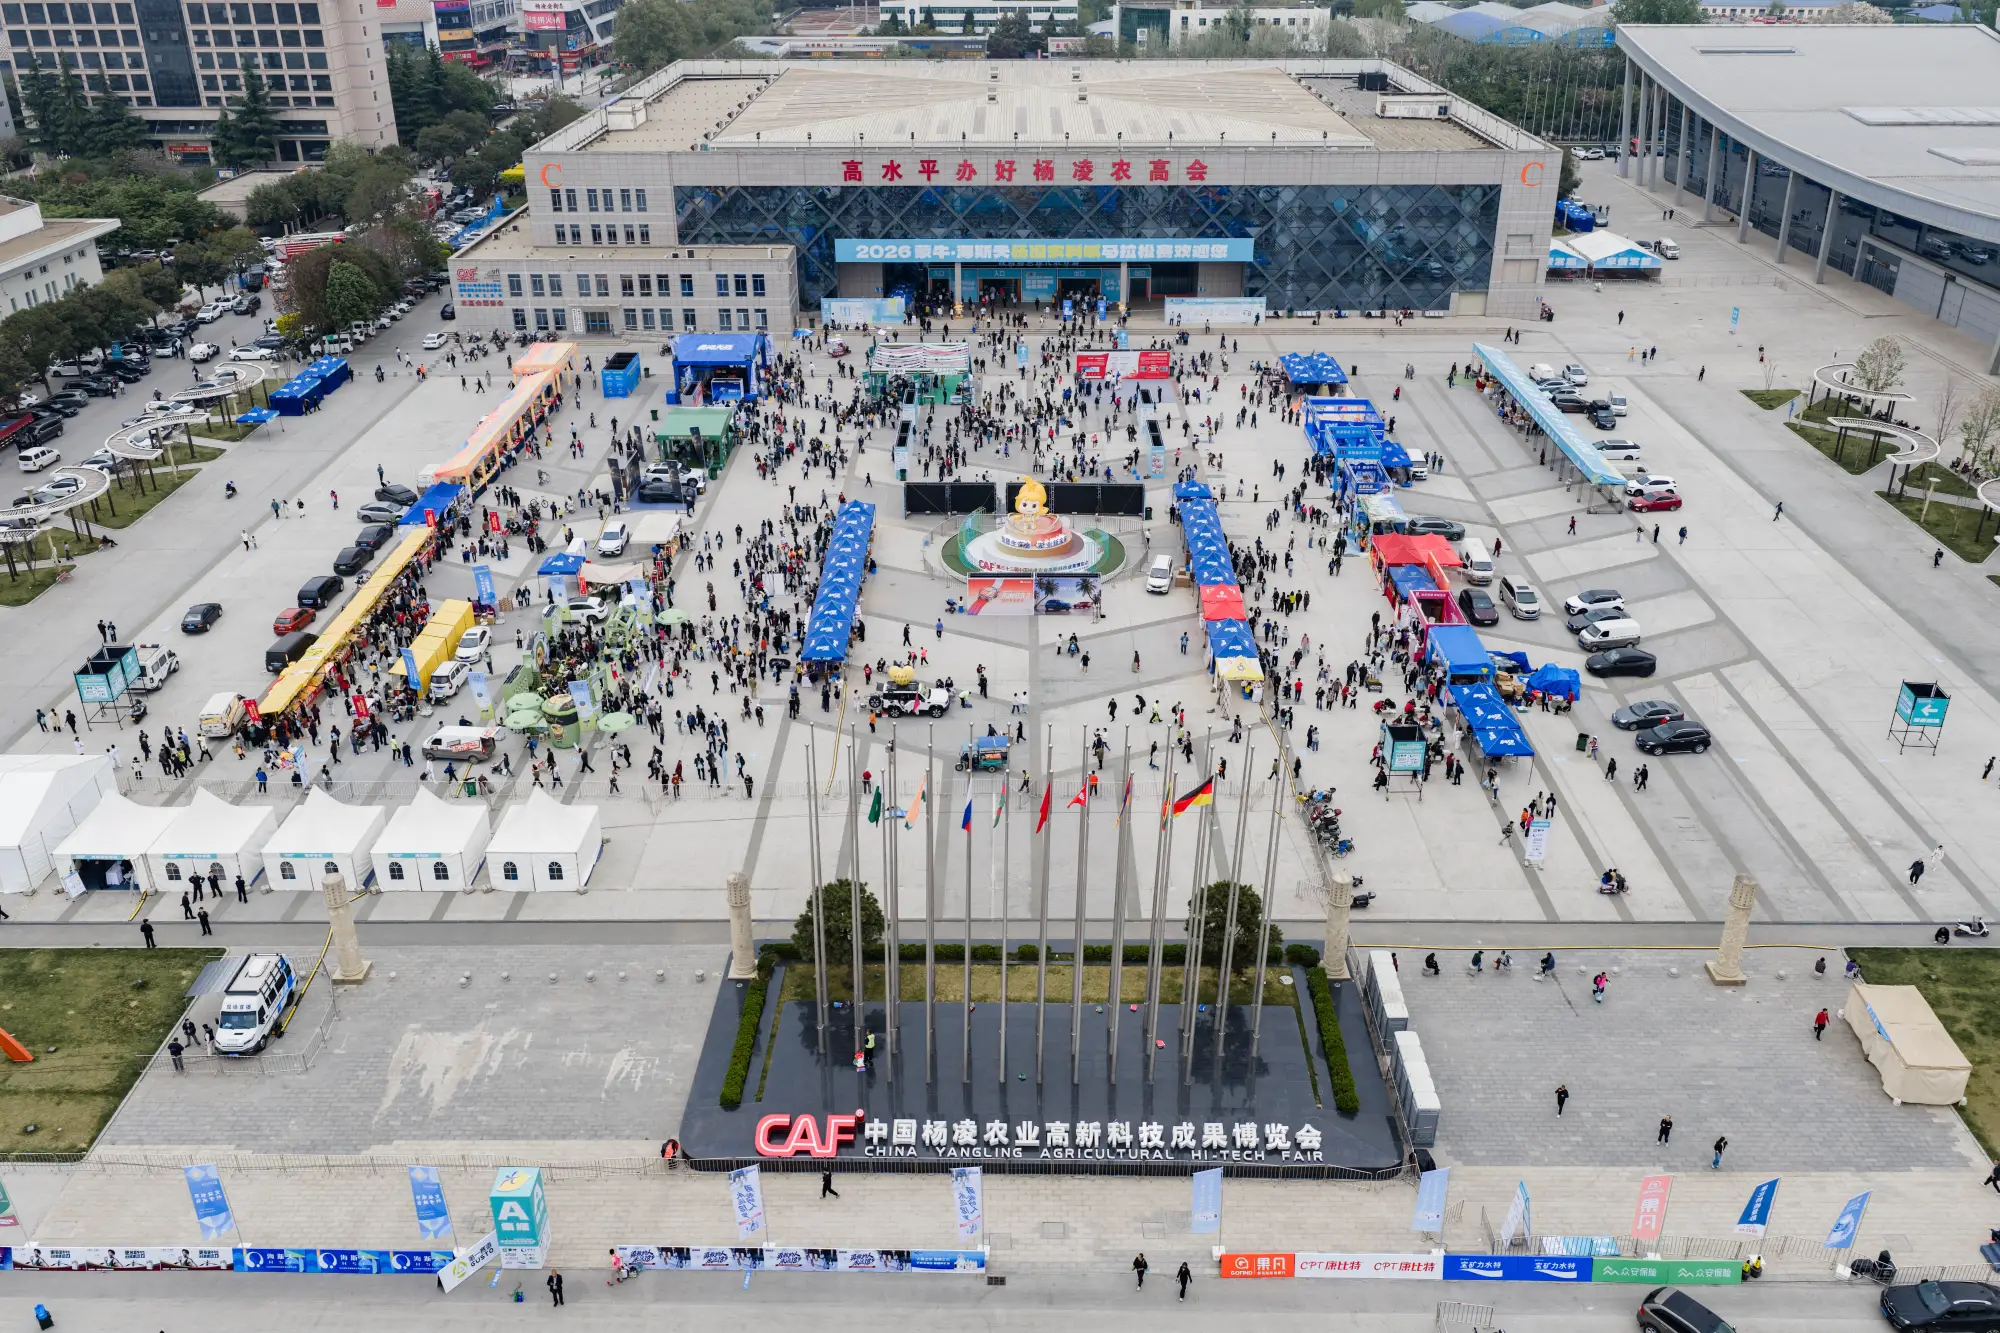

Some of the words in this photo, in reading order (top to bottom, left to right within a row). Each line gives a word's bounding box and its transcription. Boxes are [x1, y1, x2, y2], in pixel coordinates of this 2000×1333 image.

[541, 163, 562, 188] C
[842, 159, 1209, 182] 高水平办好杨凌农高会
[1520, 161, 1545, 187] C
[855, 244, 911, 259] 2026
[755, 1113, 856, 1158] CAF
[864, 1118, 1322, 1150] 中国杨凌农业高新科技成果博览会
[864, 1146, 918, 1157] CHINA
[936, 1147, 1023, 1158] YANGLING
[1040, 1148, 1175, 1160] AGRICULTURAL
[1191, 1150, 1265, 1161] HI-TECH
[1282, 1151, 1323, 1162] FAIR
[498, 1201, 530, 1220] A
[470, 1247, 494, 1267] GUSTO
[1257, 1257, 1286, 1270] 果凡
[1459, 1261, 1501, 1269] 宝矿力水特
[1534, 1262, 1576, 1270] 宝矿力水特
[1621, 1267, 1657, 1277] 众安保险
[1694, 1268, 1732, 1278] 众安保险
